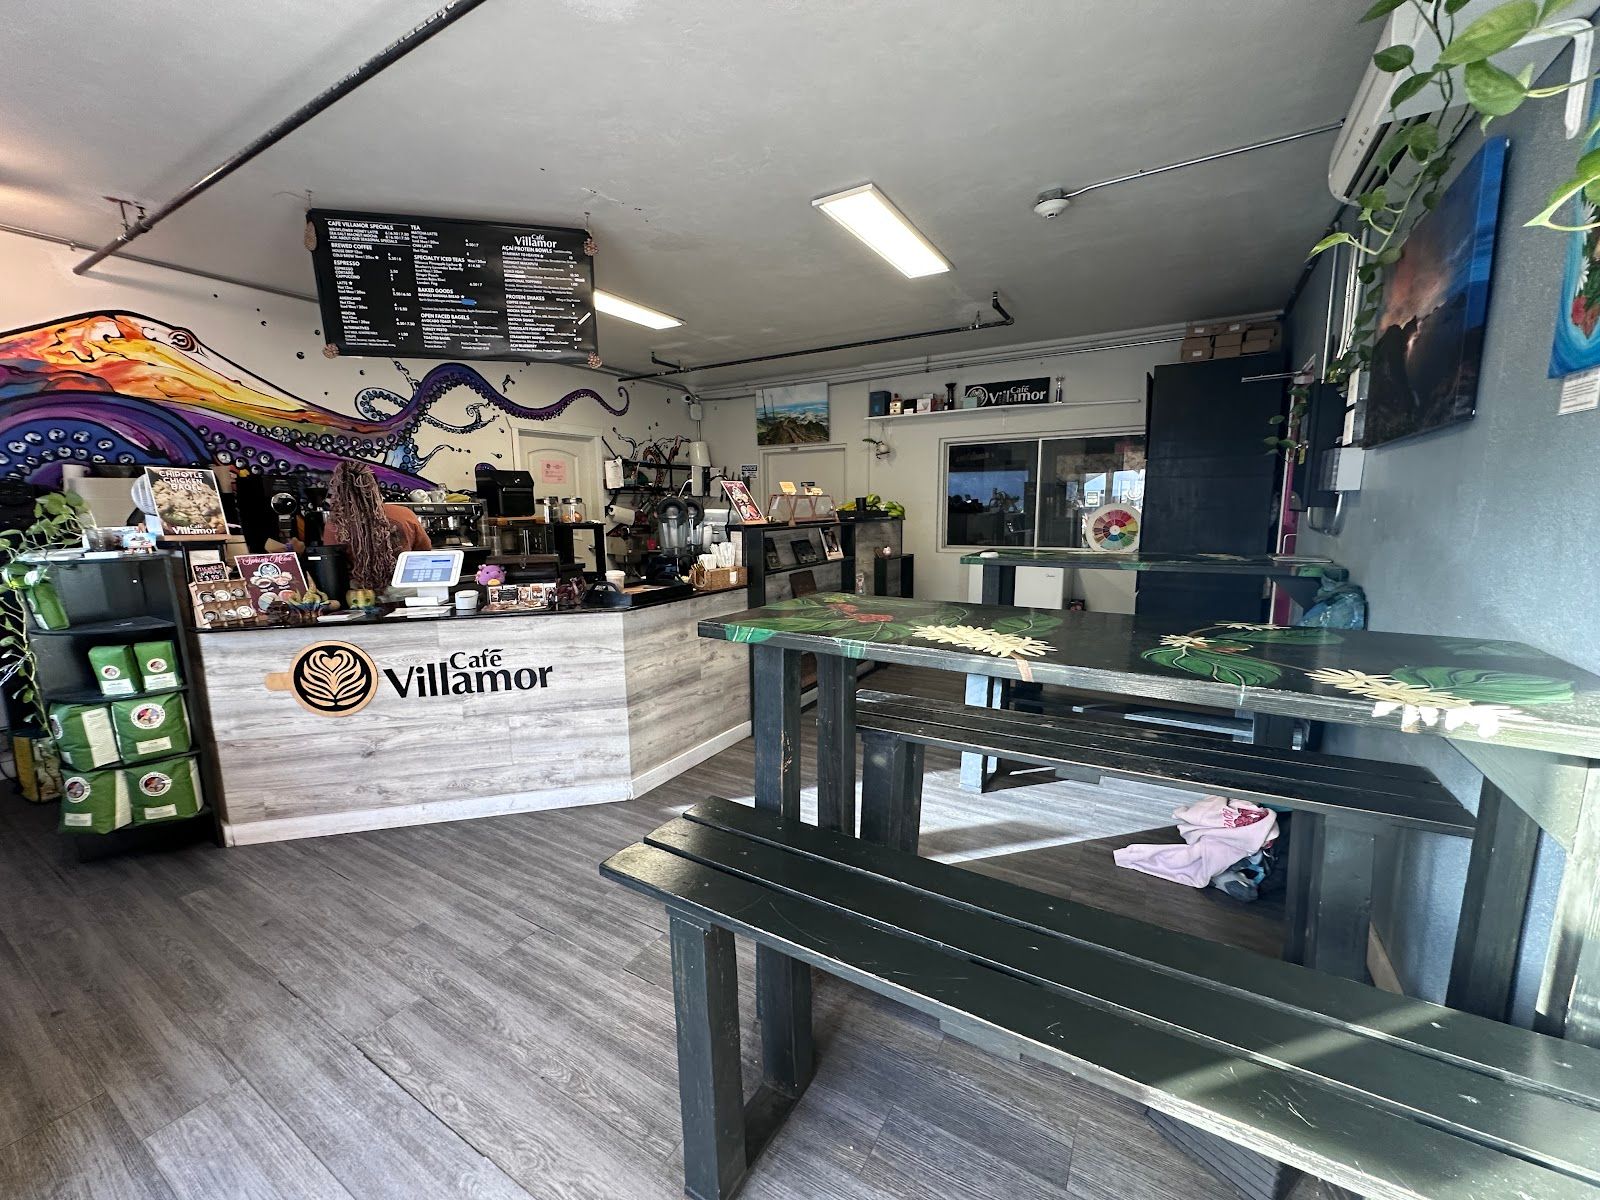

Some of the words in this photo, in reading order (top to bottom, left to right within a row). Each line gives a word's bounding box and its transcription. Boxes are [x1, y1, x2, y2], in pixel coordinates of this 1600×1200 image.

[514, 236, 557, 248] Villamor
[1010, 385, 1030, 394] Café
[159, 470, 204, 479] CHIPOTLE
[163, 477, 203, 485] CHICKEN
[172, 526, 217, 535] Villamor
[450, 648, 504, 670] Café
[383, 662, 553, 699] Villamor
